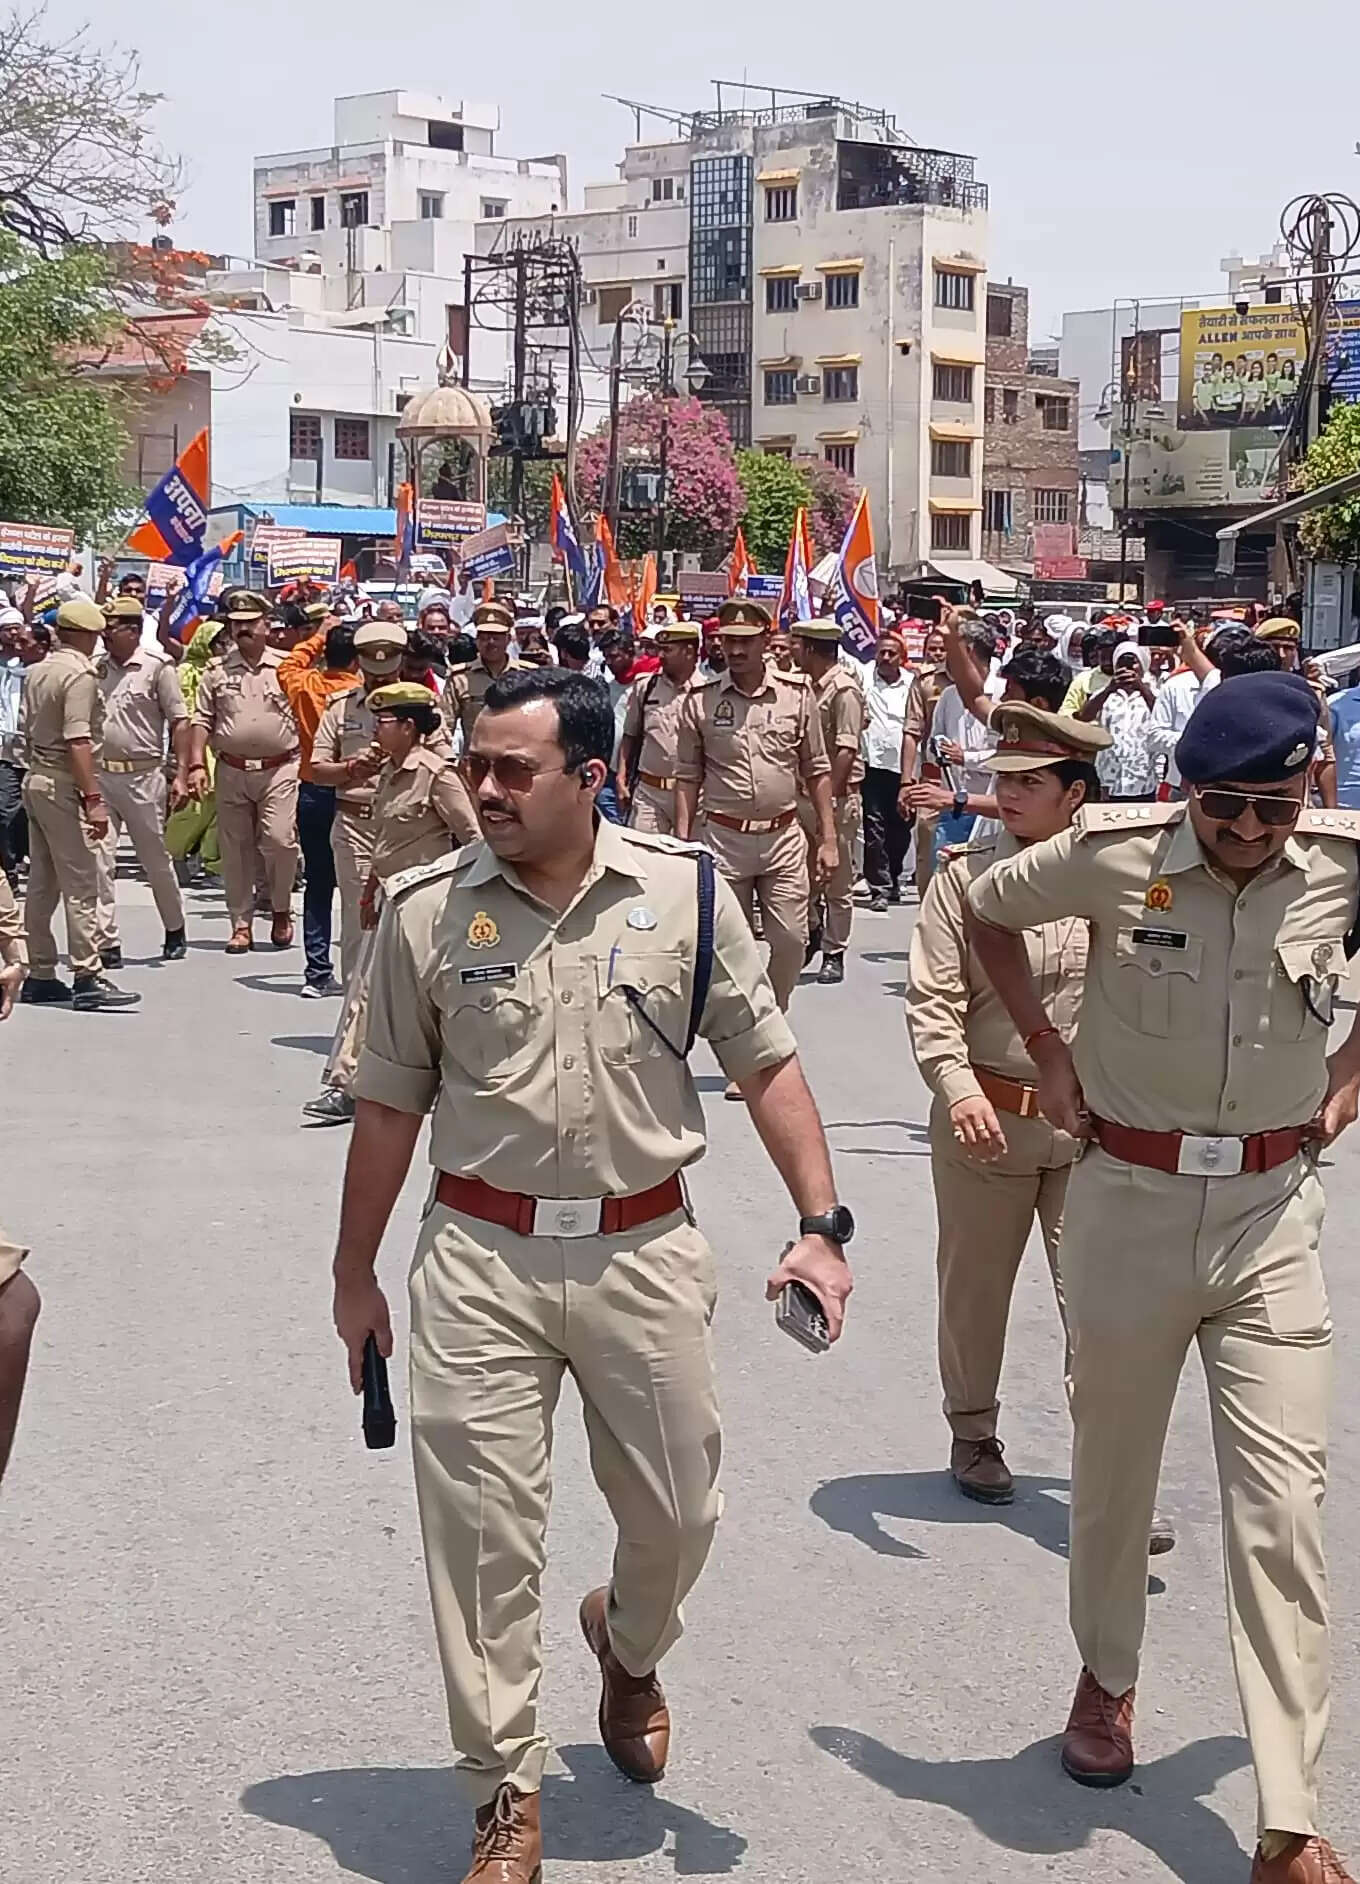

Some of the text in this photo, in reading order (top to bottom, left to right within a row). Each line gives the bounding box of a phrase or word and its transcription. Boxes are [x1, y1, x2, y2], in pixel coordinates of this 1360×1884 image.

[1240, 313, 1280, 326] सफलता
[1198, 326, 1298, 345] ALLEN आपके साथ
[163, 475, 206, 530] अपना
